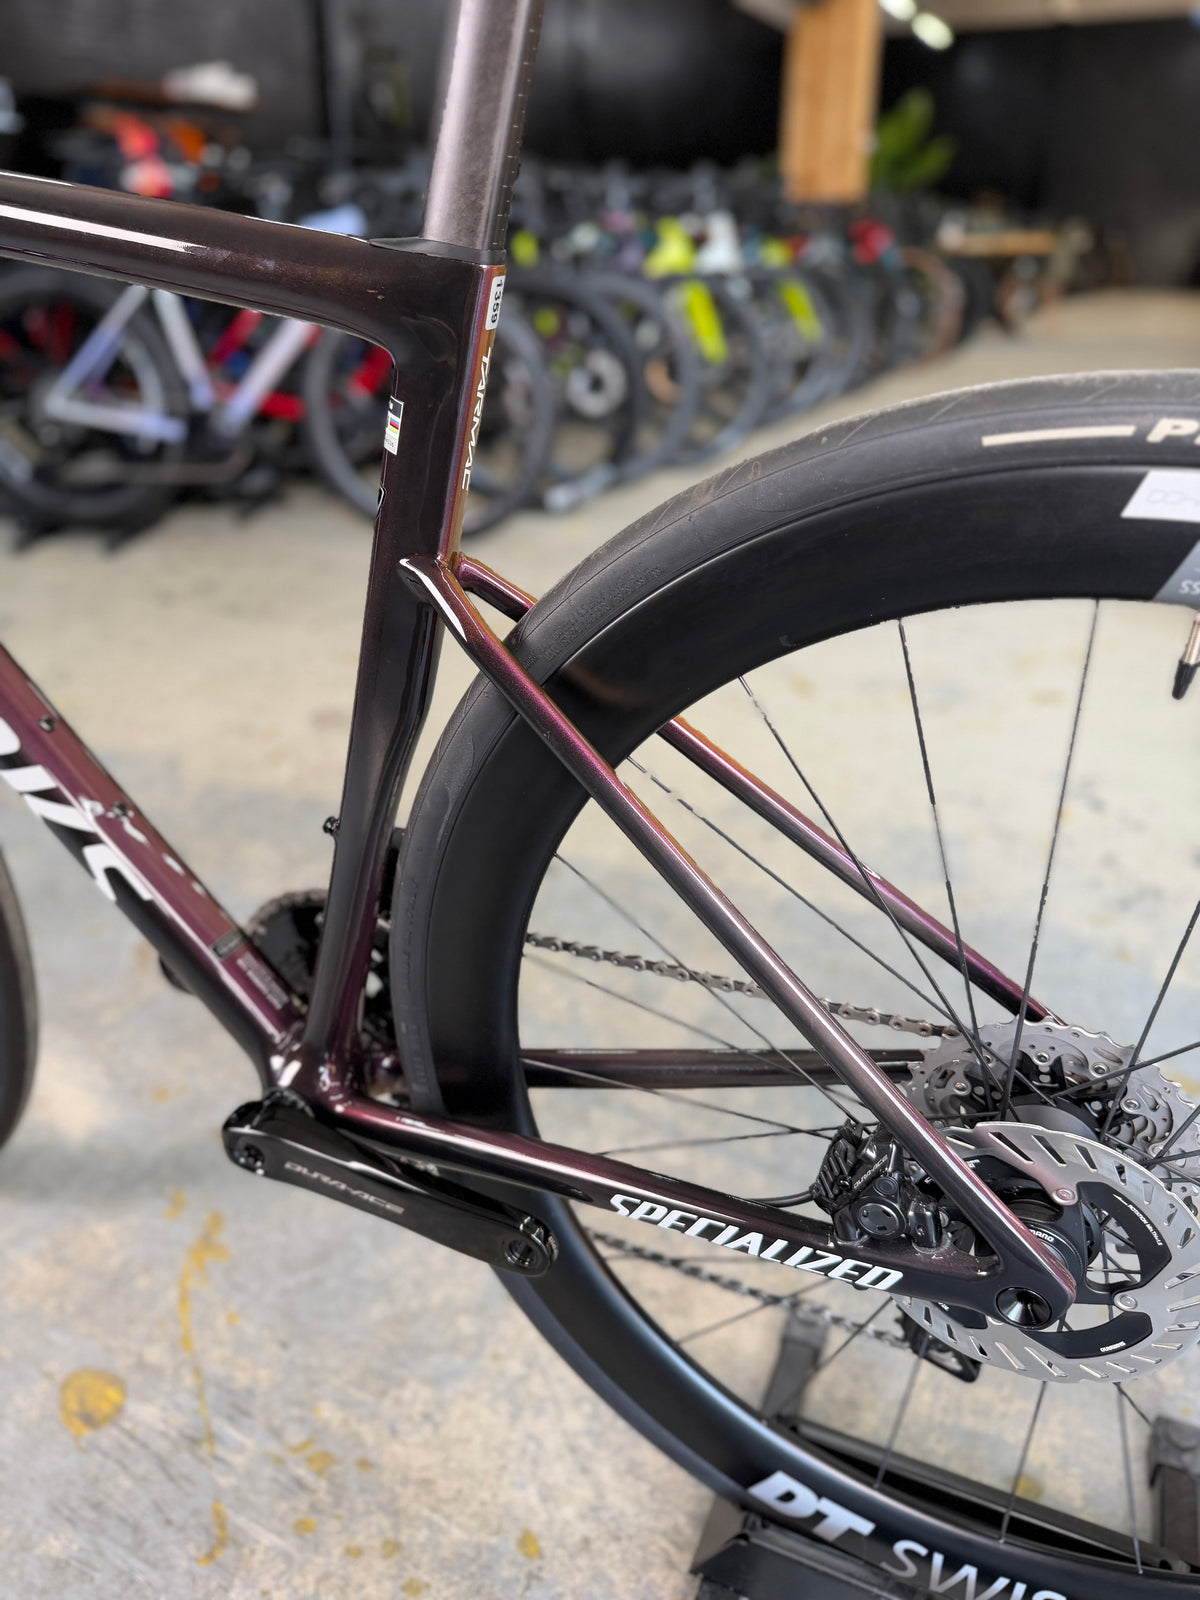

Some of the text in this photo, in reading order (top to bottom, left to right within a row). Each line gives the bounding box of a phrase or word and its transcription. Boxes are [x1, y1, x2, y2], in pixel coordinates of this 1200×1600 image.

[462, 346, 492, 491] TARMAC
[284, 1161, 405, 1215] DURA-ACE
[609, 1193, 904, 1291] SPECIALIZED
[747, 1470, 876, 1542] DT
